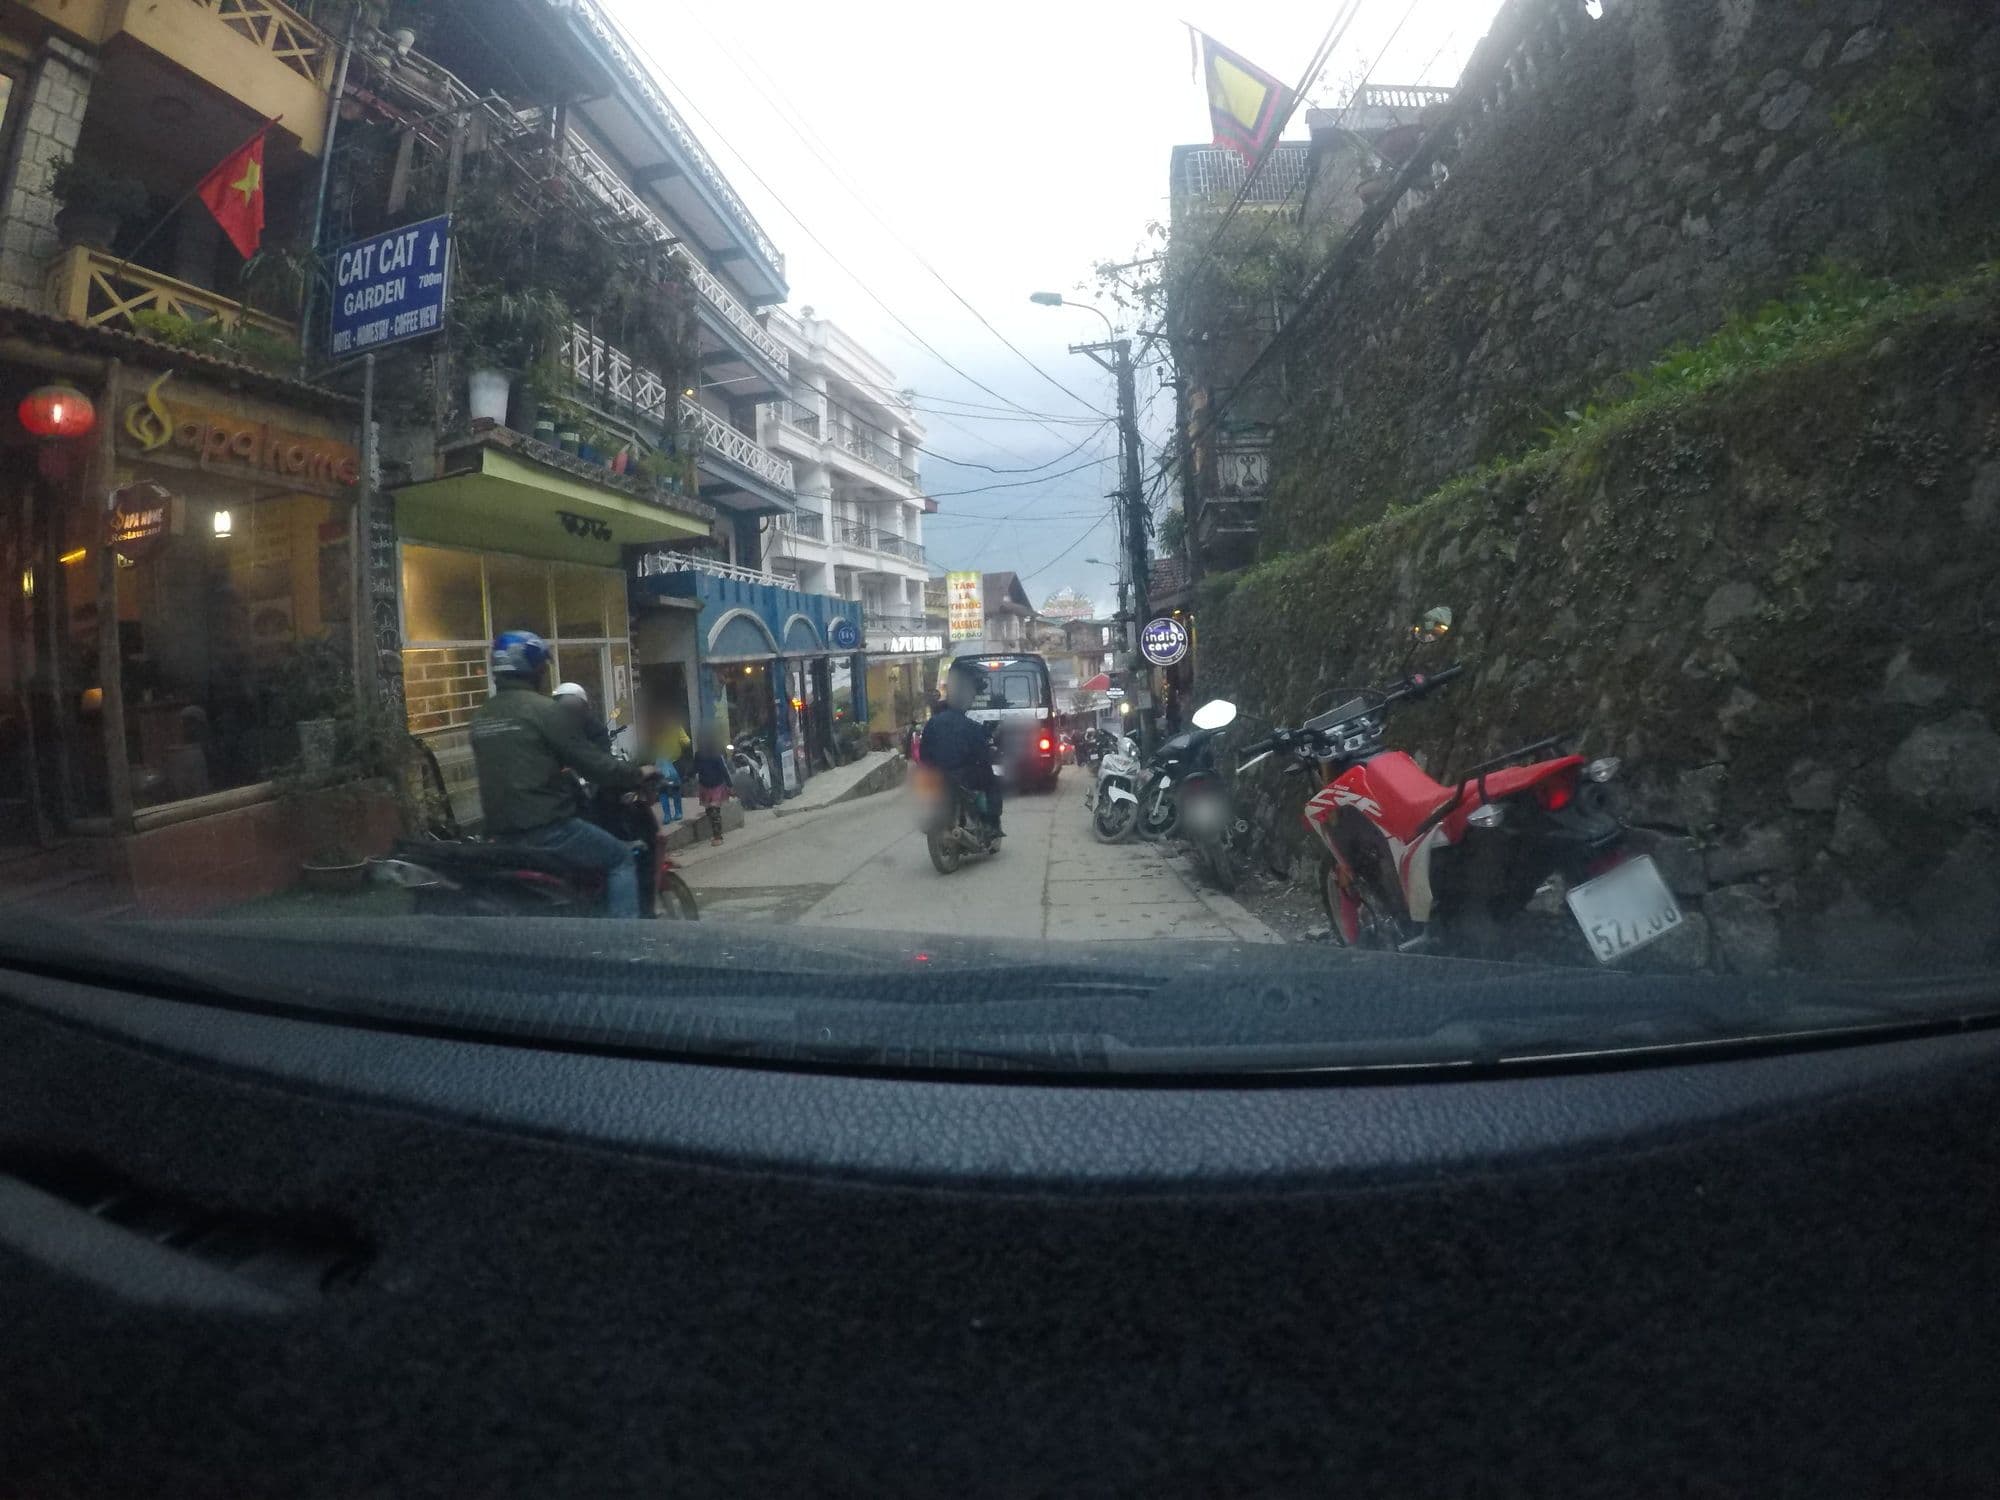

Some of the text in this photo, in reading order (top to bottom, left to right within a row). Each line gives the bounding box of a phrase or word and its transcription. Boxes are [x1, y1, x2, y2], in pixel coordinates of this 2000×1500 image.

[339, 231, 420, 287] CAT CAT
[344, 277, 406, 316] GARDEN
[395, 309, 419, 335] COFFEE
[1145, 631, 1184, 647] indigo
